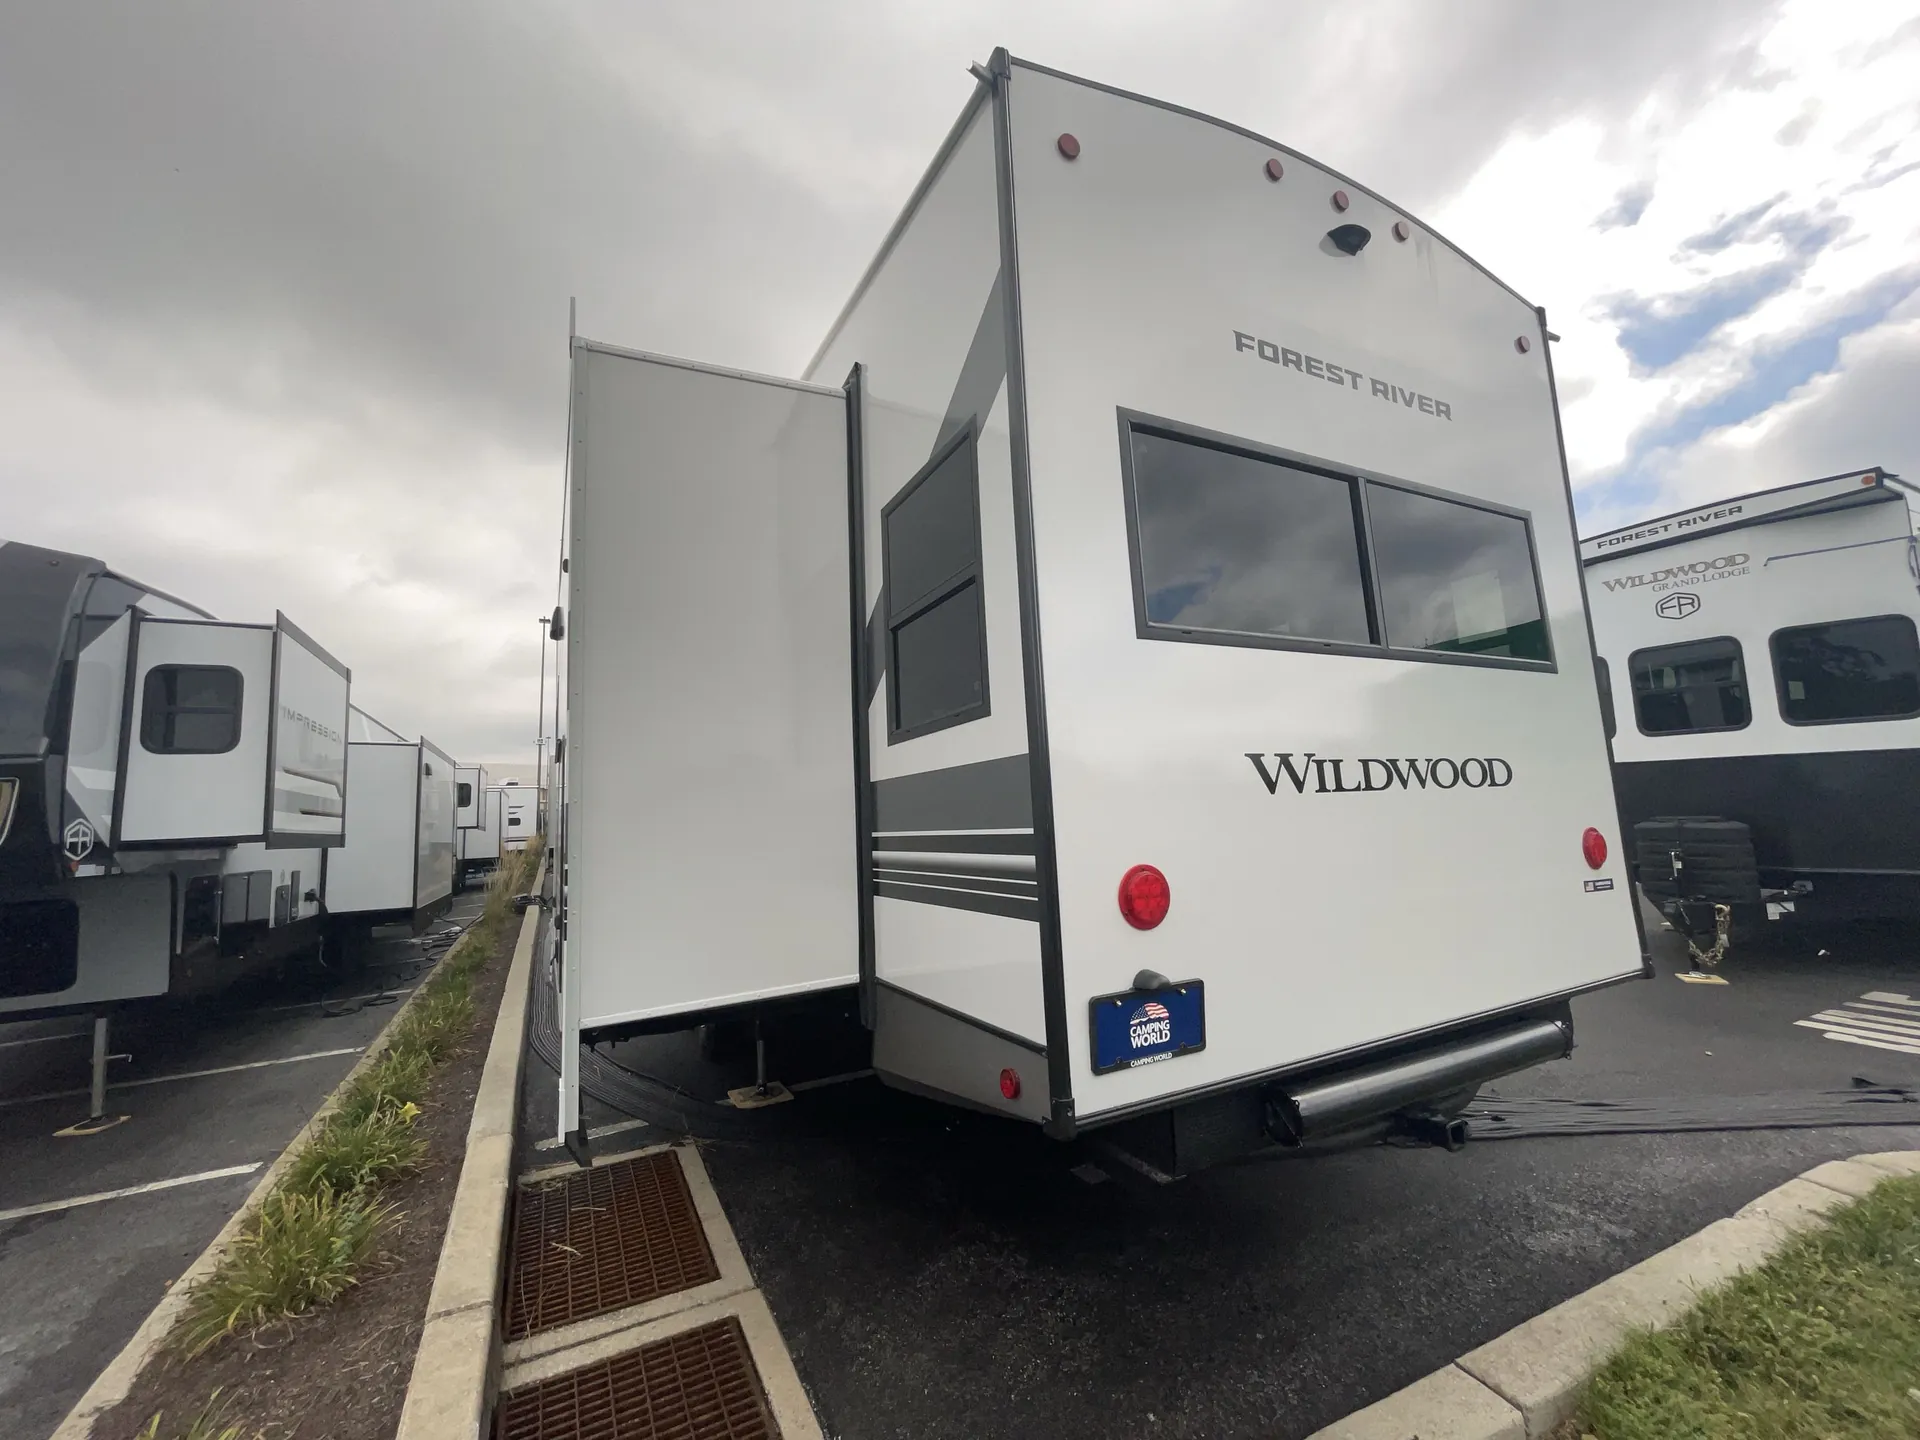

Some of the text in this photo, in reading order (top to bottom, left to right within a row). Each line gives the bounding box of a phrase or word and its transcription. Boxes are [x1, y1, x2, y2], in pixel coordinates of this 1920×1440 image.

[1232, 330, 1452, 421] FOREST RIVER
[1597, 505, 1743, 549] FOREST RIVER
[1602, 553, 1750, 592] WILDWOOD
[1652, 566, 1750, 592] GRAND LODGE
[1244, 753, 1513, 795] WILDWOOD
[1130, 1020, 1170, 1037] CAMPING
[1130, 1030, 1170, 1049] WORLD
[1130, 1052, 1172, 1068] CAMPING WORLD
